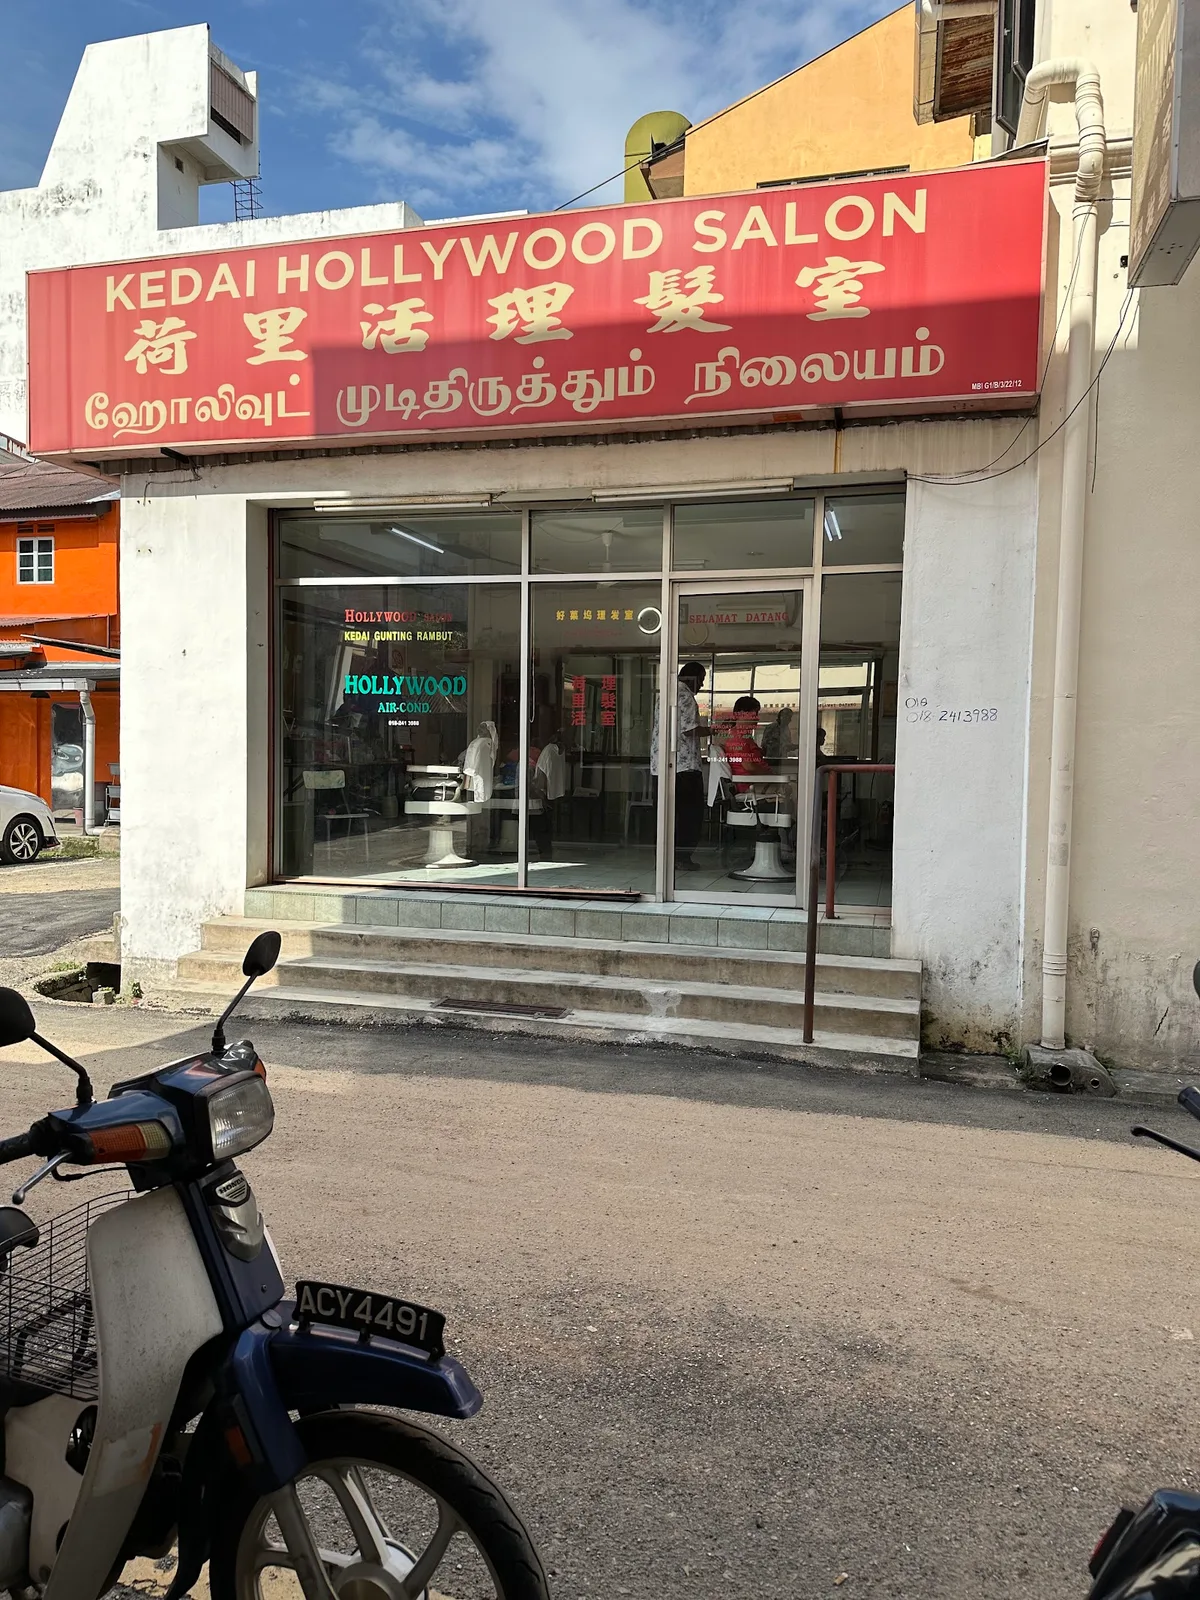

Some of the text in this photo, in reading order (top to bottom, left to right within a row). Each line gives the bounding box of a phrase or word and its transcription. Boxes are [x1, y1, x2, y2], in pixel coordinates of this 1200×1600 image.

[106, 188, 927, 313] KEDAI HOLLYWOOD SALON
[124, 256, 886, 376] 荷里活理髮室
[84, 326, 946, 438] ஹோலிவுட் முடிதிருத்தும் நிலையம்
[344, 609, 417, 622] HOLLYWOOD
[690, 611, 789, 624] SELAMAT DATANG
[344, 631, 453, 641] KEDAI GUNTING RAMBUT
[344, 674, 467, 696] HOLLYWOOD
[377, 702, 432, 713] AIR-COND.
[219, 1177, 245, 1194] HONDA
[300, 1285, 428, 1341] ACY4491
